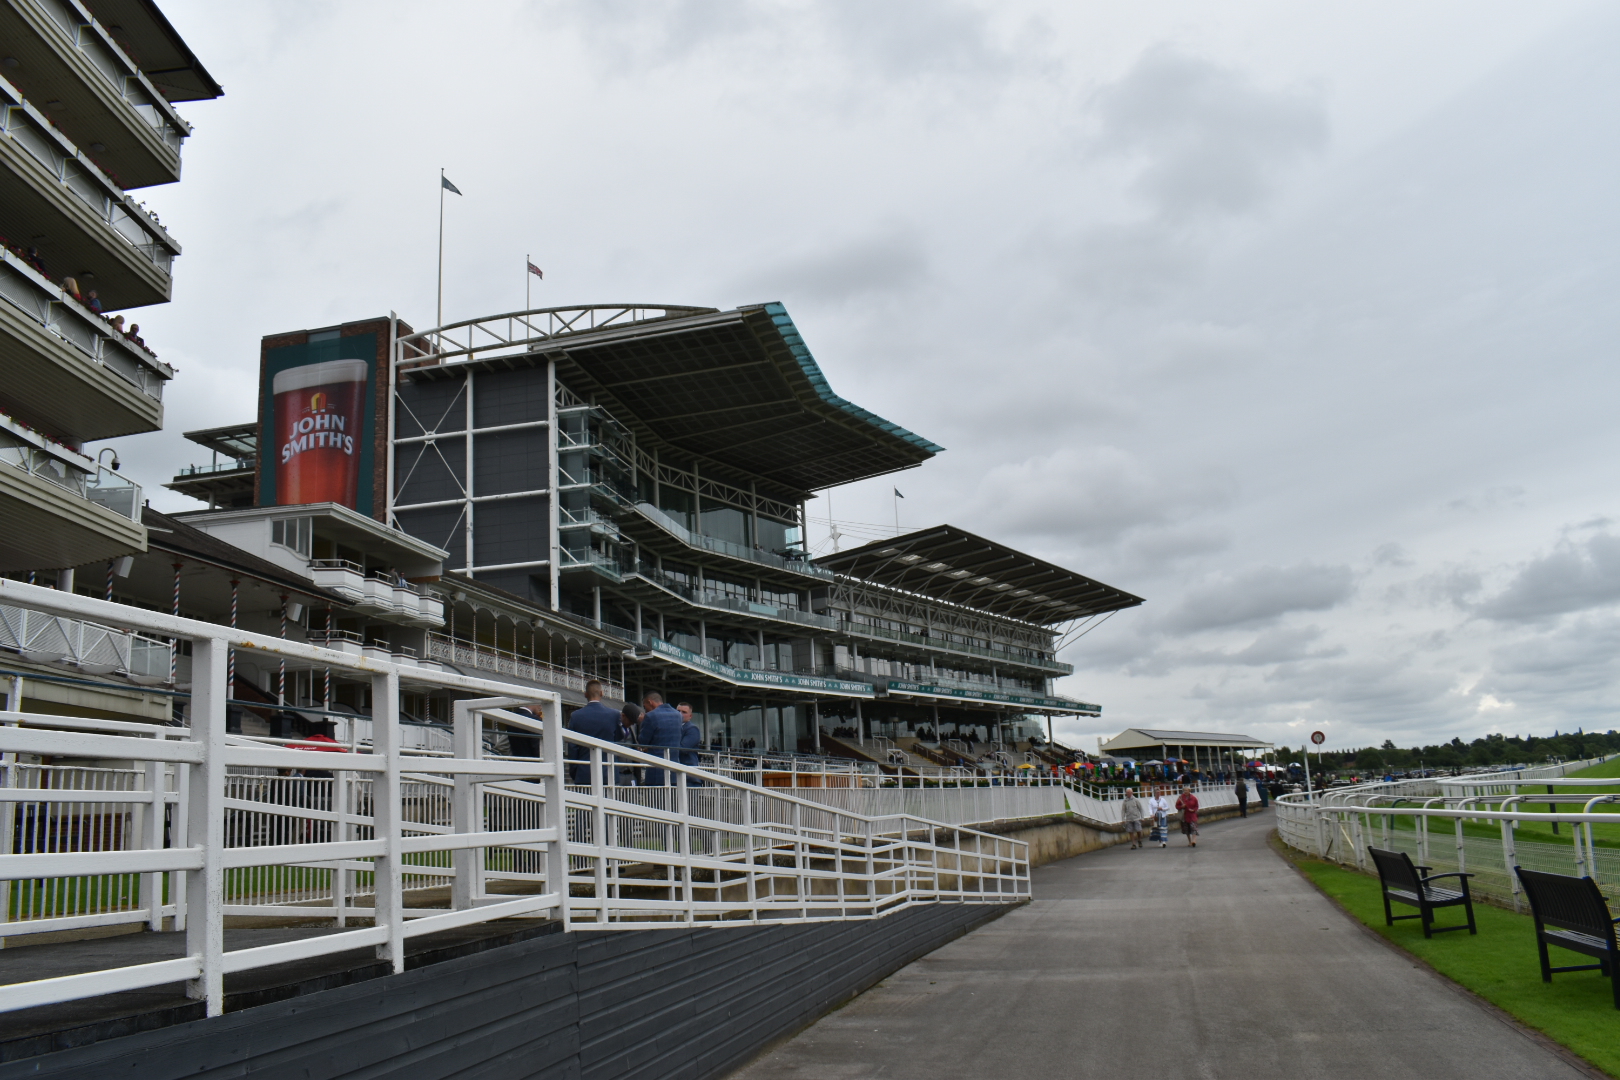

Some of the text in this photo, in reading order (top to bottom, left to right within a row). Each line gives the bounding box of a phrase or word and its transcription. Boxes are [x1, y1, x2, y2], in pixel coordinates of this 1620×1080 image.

[289, 414, 345, 439] JOHN
[282, 431, 353, 464] SMITH'S
[659, 641, 669, 652] JOHN
[751, 672, 783, 683] JOHN SMITH'S
[797, 678, 810, 687] JOHN
[839, 682, 851, 690] JOHN
